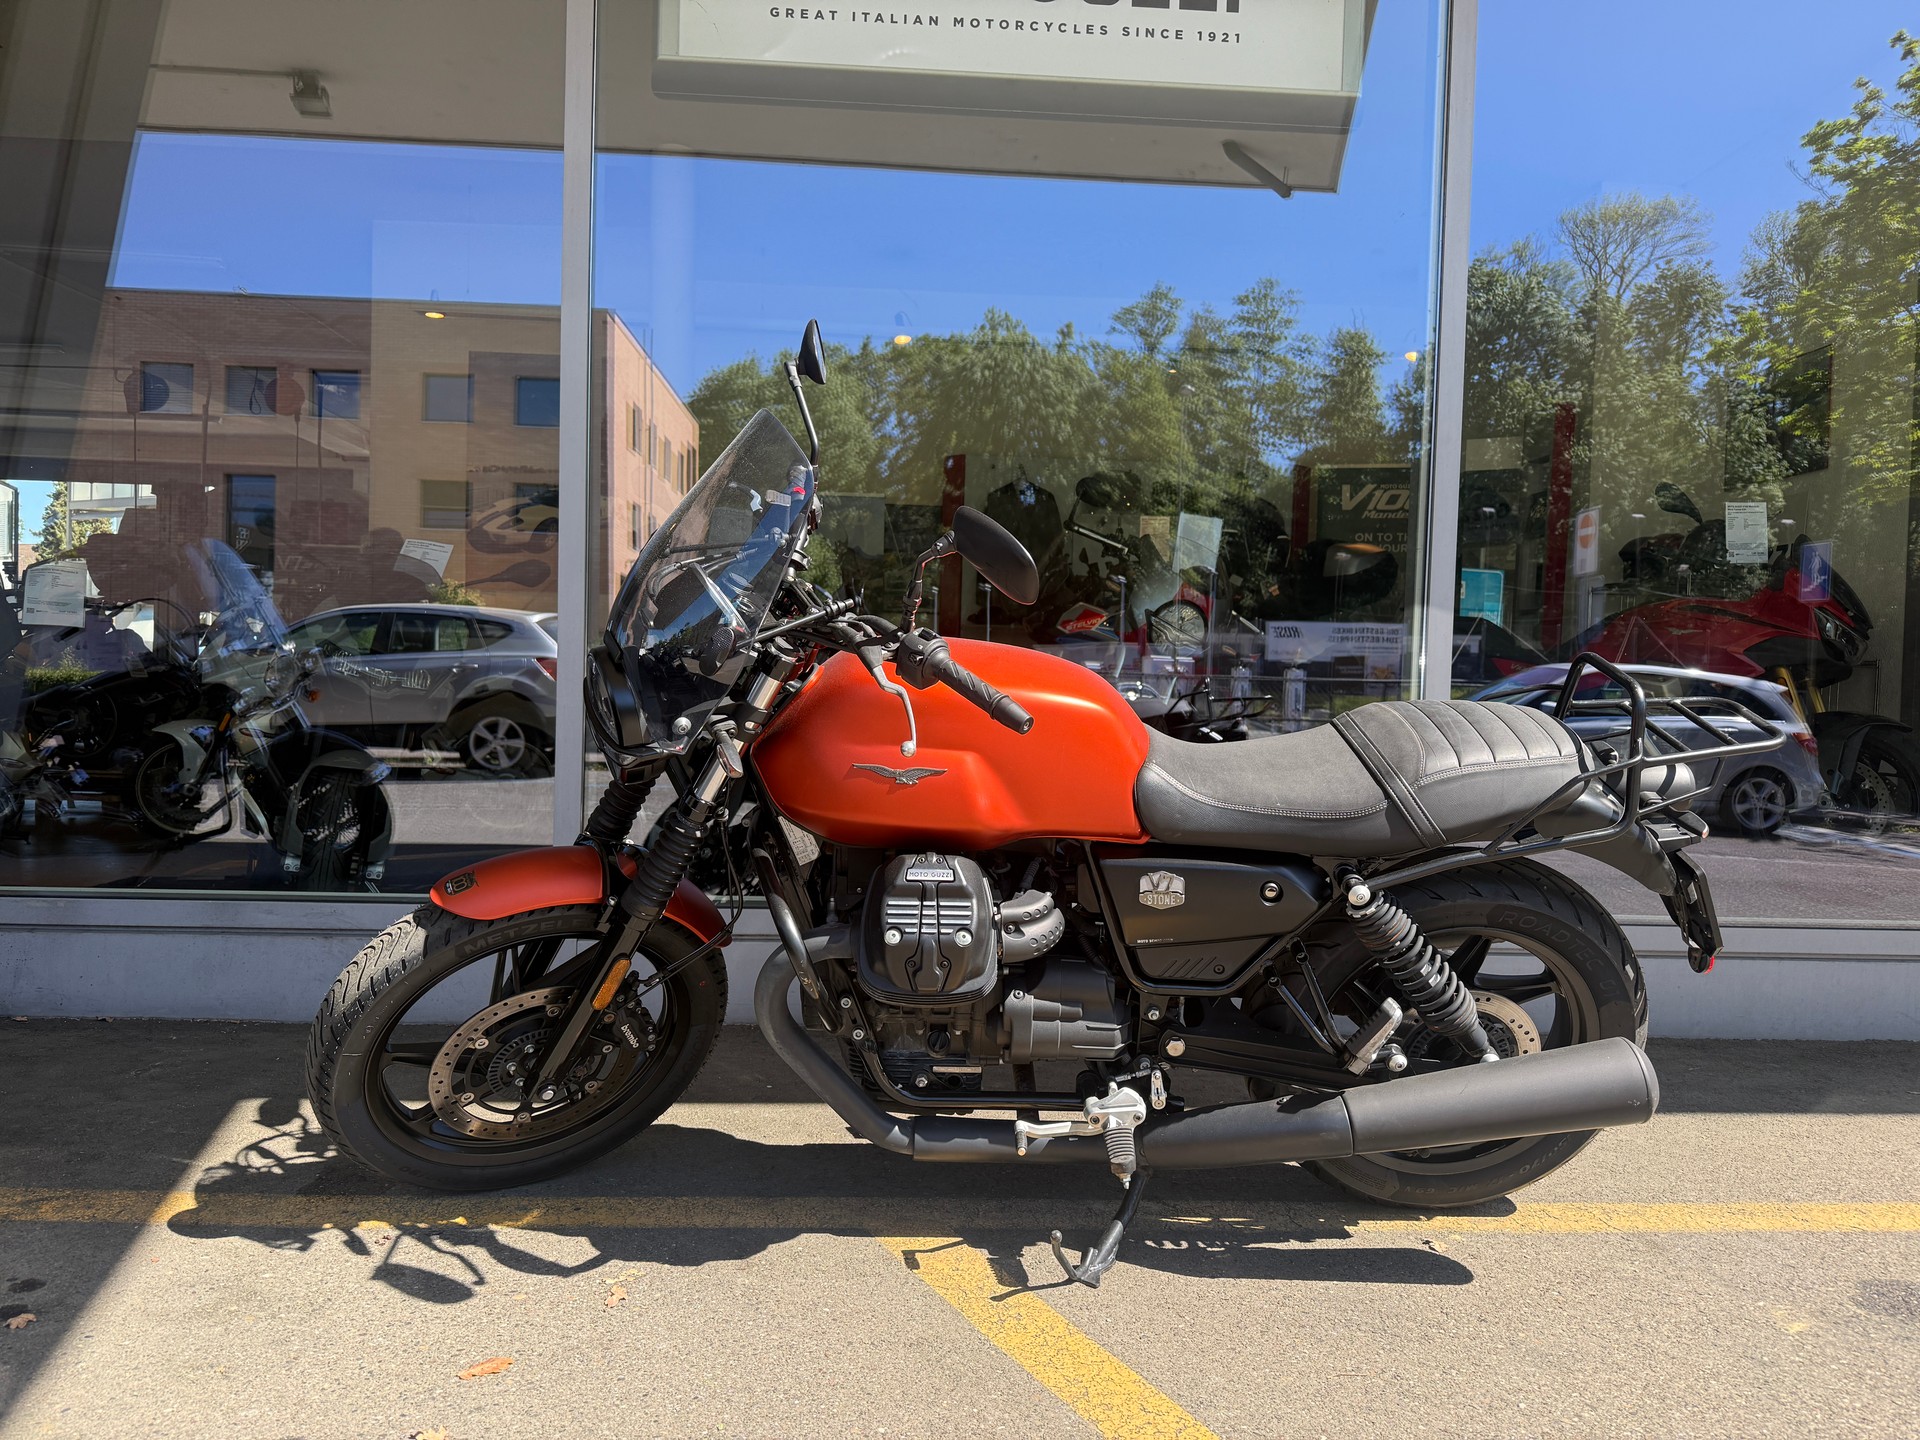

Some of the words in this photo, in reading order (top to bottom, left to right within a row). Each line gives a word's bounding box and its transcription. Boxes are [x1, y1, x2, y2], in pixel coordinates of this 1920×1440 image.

[769, 6, 838, 21] GREAT
[851, 11, 939, 26] ITALIAN
[953, 17, 1108, 35] MOTORCYCLES
[1122, 26, 1184, 40] SINCE
[1197, 31, 1240, 43] 1921
[1355, 532, 1373, 542] ON
[1377, 532, 1393, 542] TO
[1147, 871, 1175, 891] V7
[1147, 894, 1176, 905] STONE
[1497, 910, 1604, 971] ROADTEC
[620, 1023, 640, 1049] brembo
